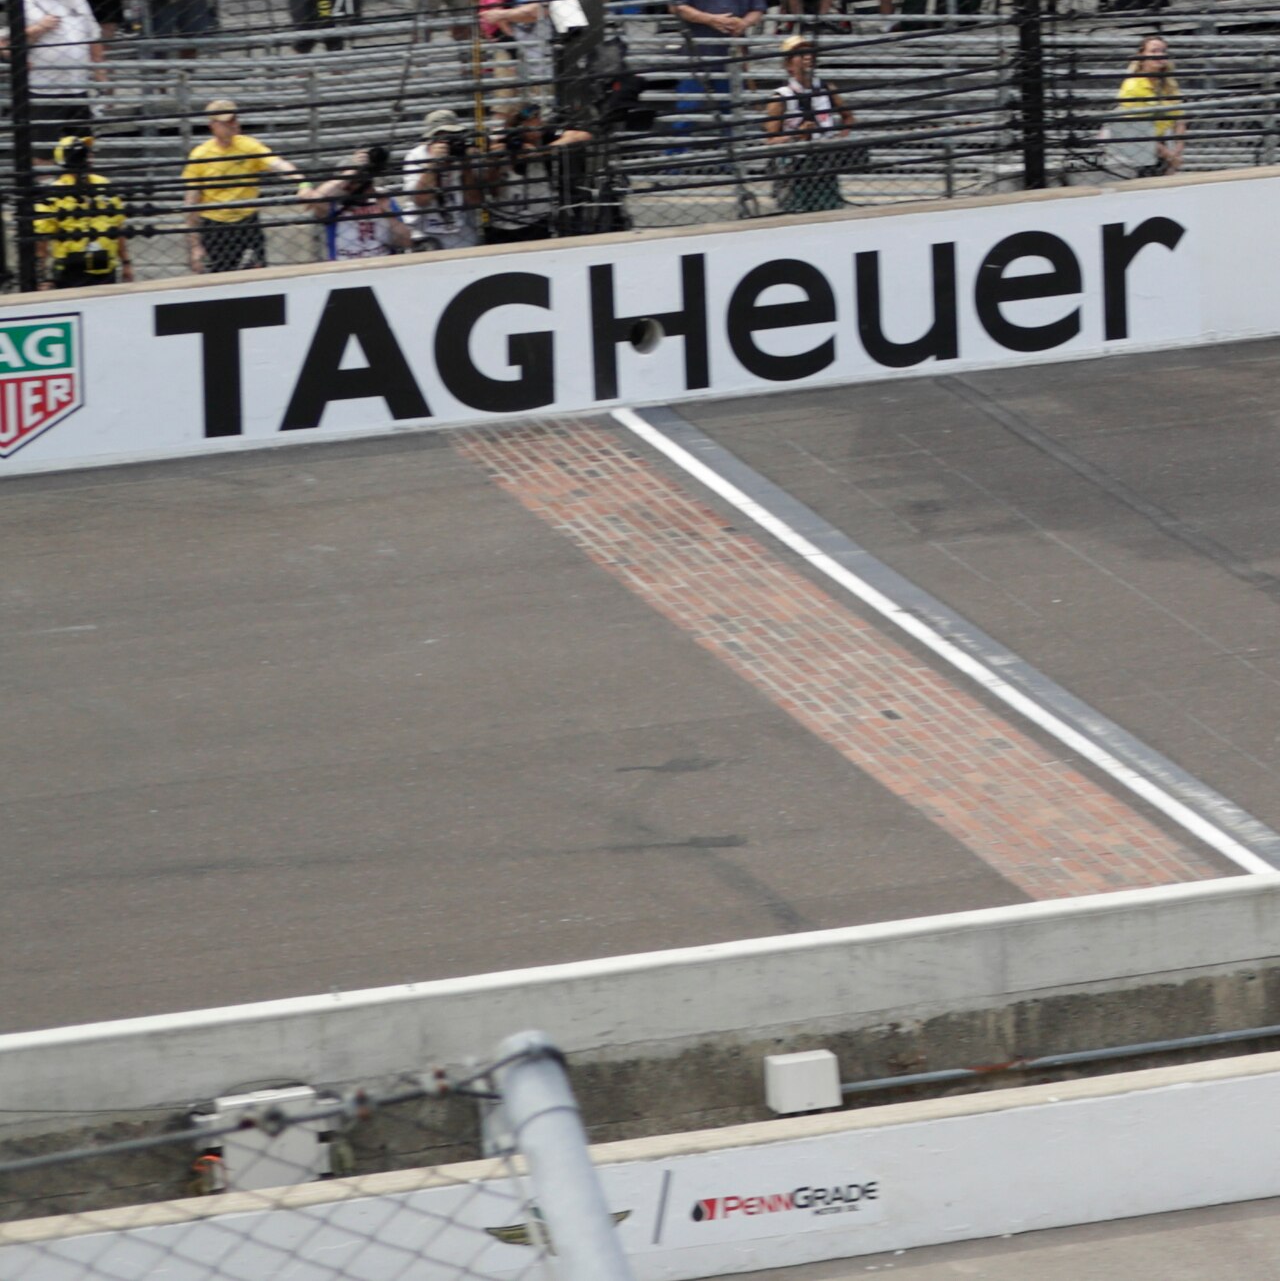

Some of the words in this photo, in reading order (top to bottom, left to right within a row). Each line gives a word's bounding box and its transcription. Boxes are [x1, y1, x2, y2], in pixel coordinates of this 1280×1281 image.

[0, 327, 66, 367] AG
[155, 271, 556, 439] TAG
[589, 215, 1187, 402] Heuer
[0, 377, 72, 444] UER
